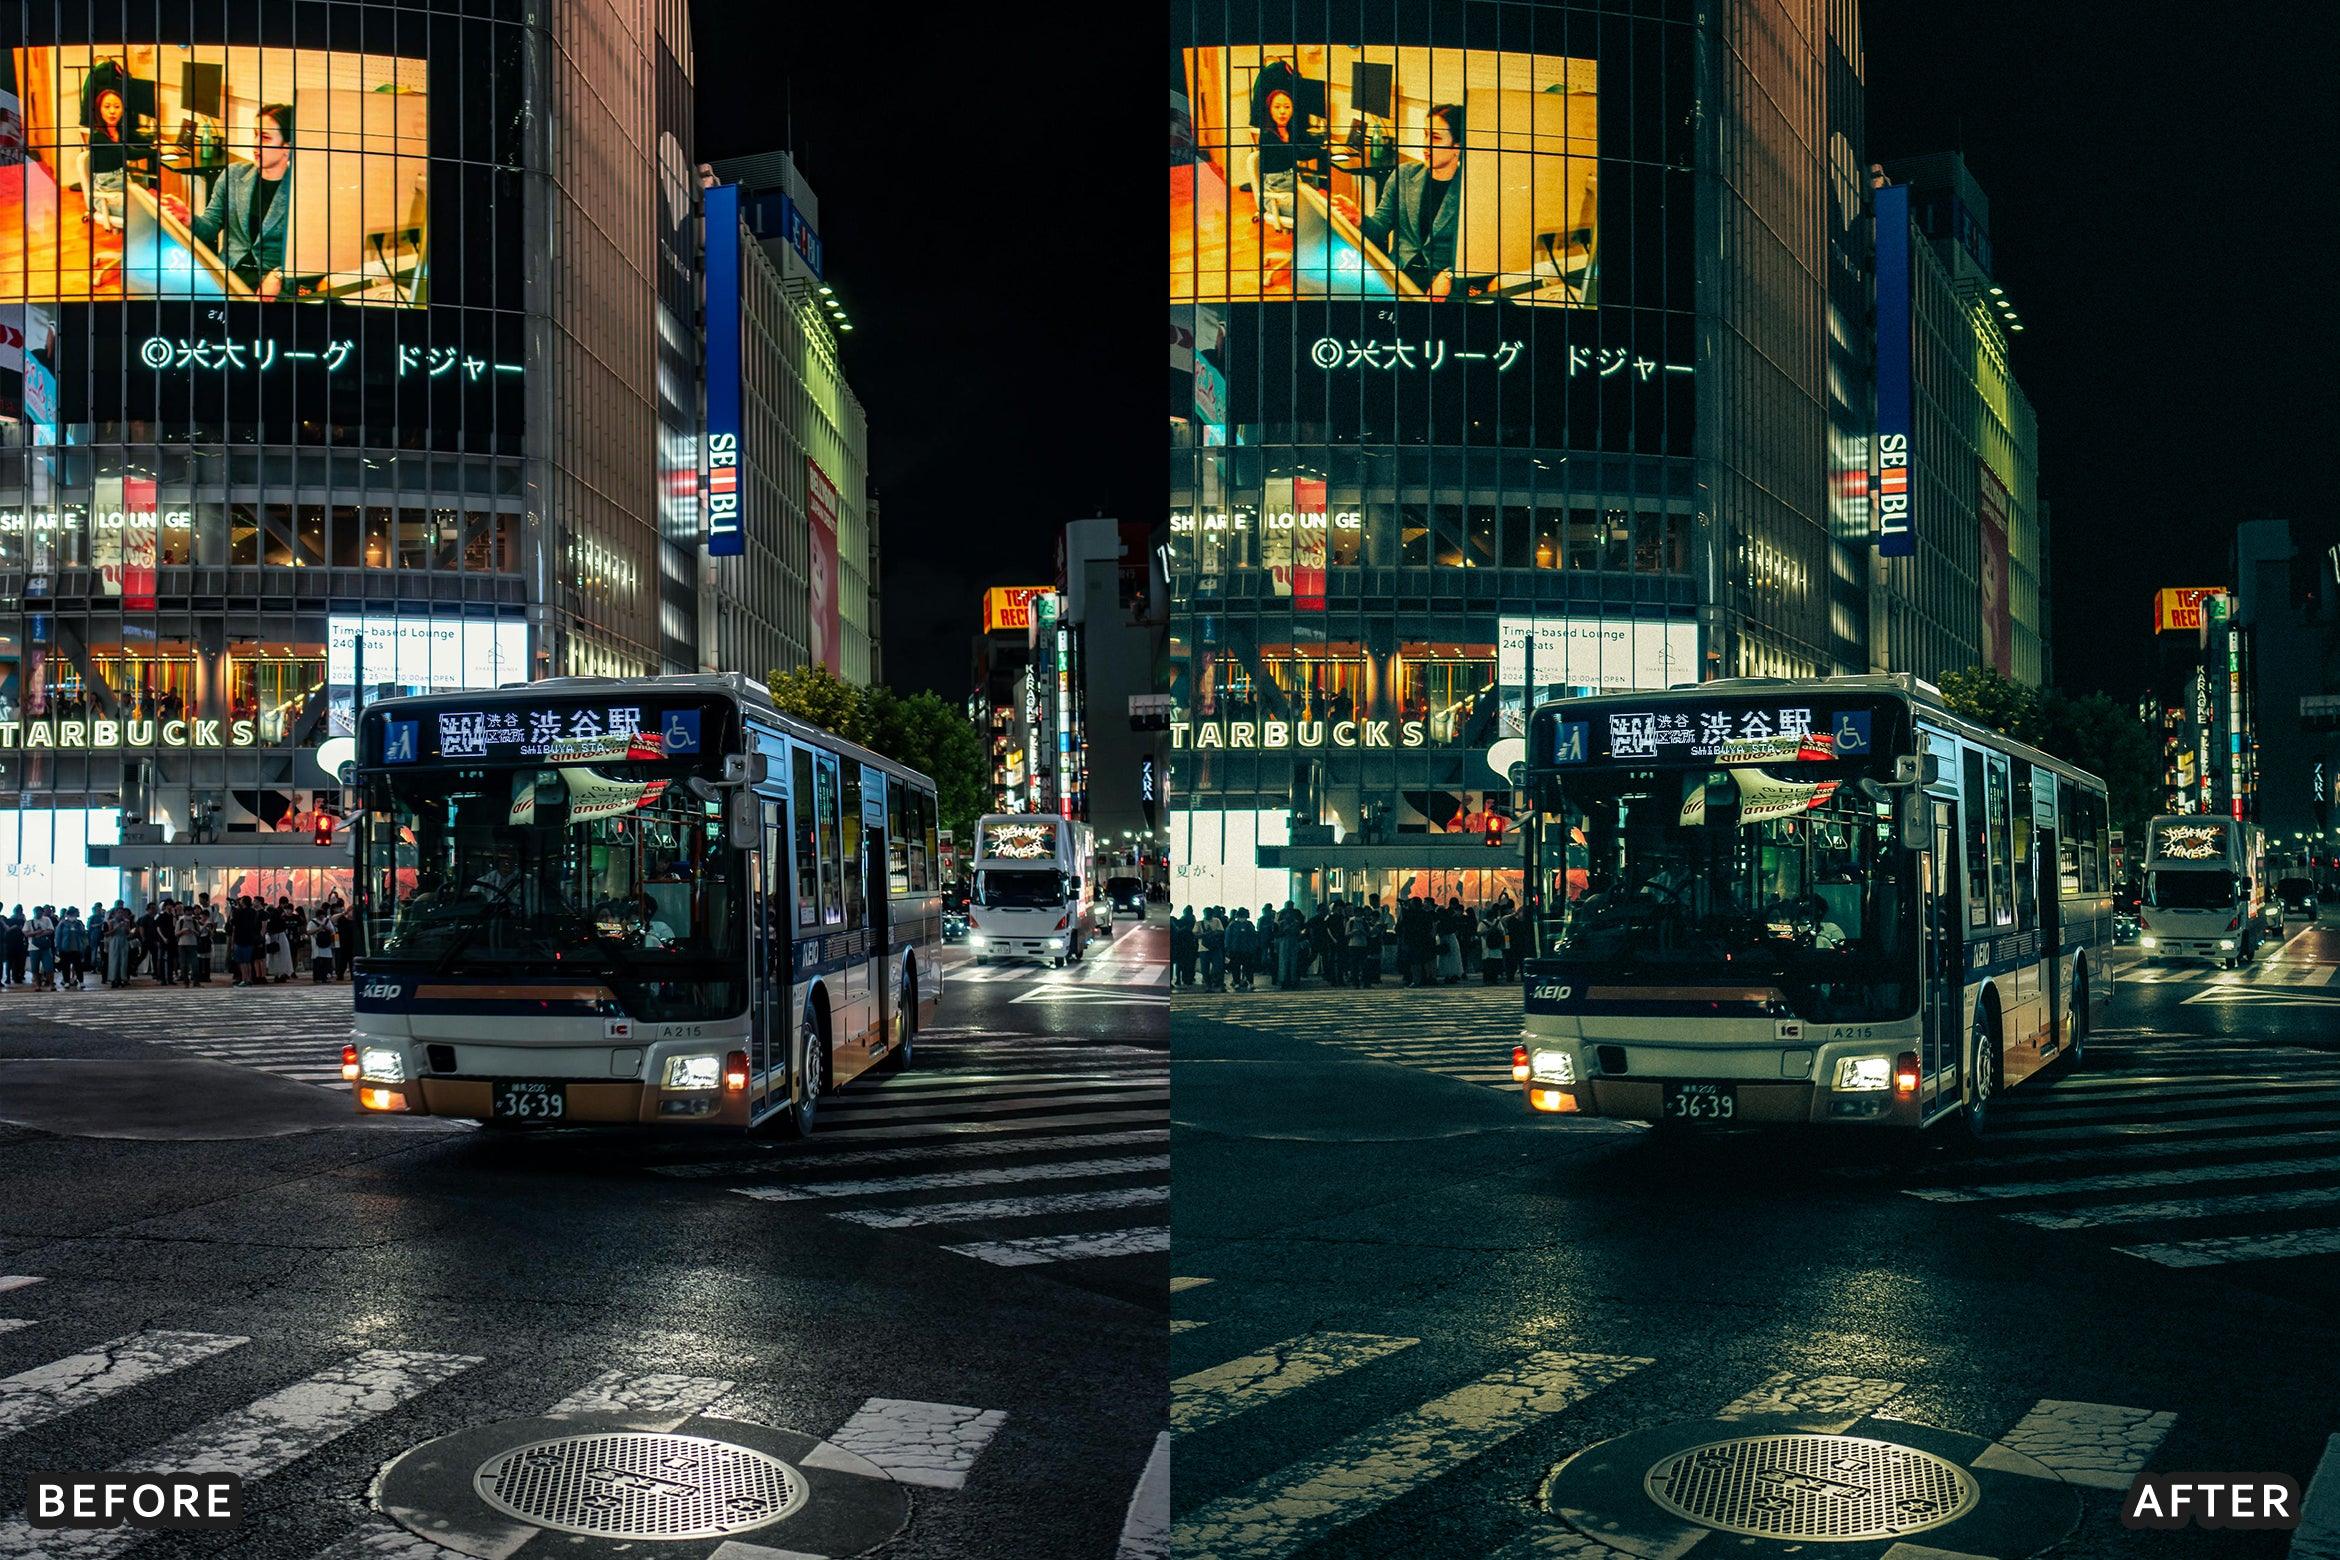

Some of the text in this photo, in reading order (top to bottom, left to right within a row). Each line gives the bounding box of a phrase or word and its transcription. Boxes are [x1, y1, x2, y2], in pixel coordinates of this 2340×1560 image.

[399, 344, 522, 380] ドジャー
[1570, 345, 1693, 381] ドジャー
[709, 433, 737, 536] SEIBU
[1880, 434, 1908, 537] SEIBU
[1, 511, 192, 531] SHARE LOUNGE
[1172, 512, 1363, 532] SHARE LOUNGE
[1004, 589, 1049, 606] TOW
[2175, 590, 2220, 607] TOW
[333, 626, 455, 641] Time-based Lounge
[1504, 627, 1626, 642] Time-based Lounge
[1025, 664, 1036, 723] KARAOKE
[2196, 665, 2207, 724] KARAOKE
[529, 708, 644, 743] 渋谷駅
[1700, 709, 1815, 744] 渋谷駅
[520, 744, 574, 755] SHIBUYA
[1691, 745, 1745, 756] SHIBUYA
[1142, 761, 1154, 801] ZARA
[2313, 762, 2325, 802] ZARA
[363, 984, 402, 1000] KEIO
[1534, 985, 1573, 1001] KEIO
[664, 1026, 702, 1037] A215
[1835, 1027, 1873, 1038] A215
